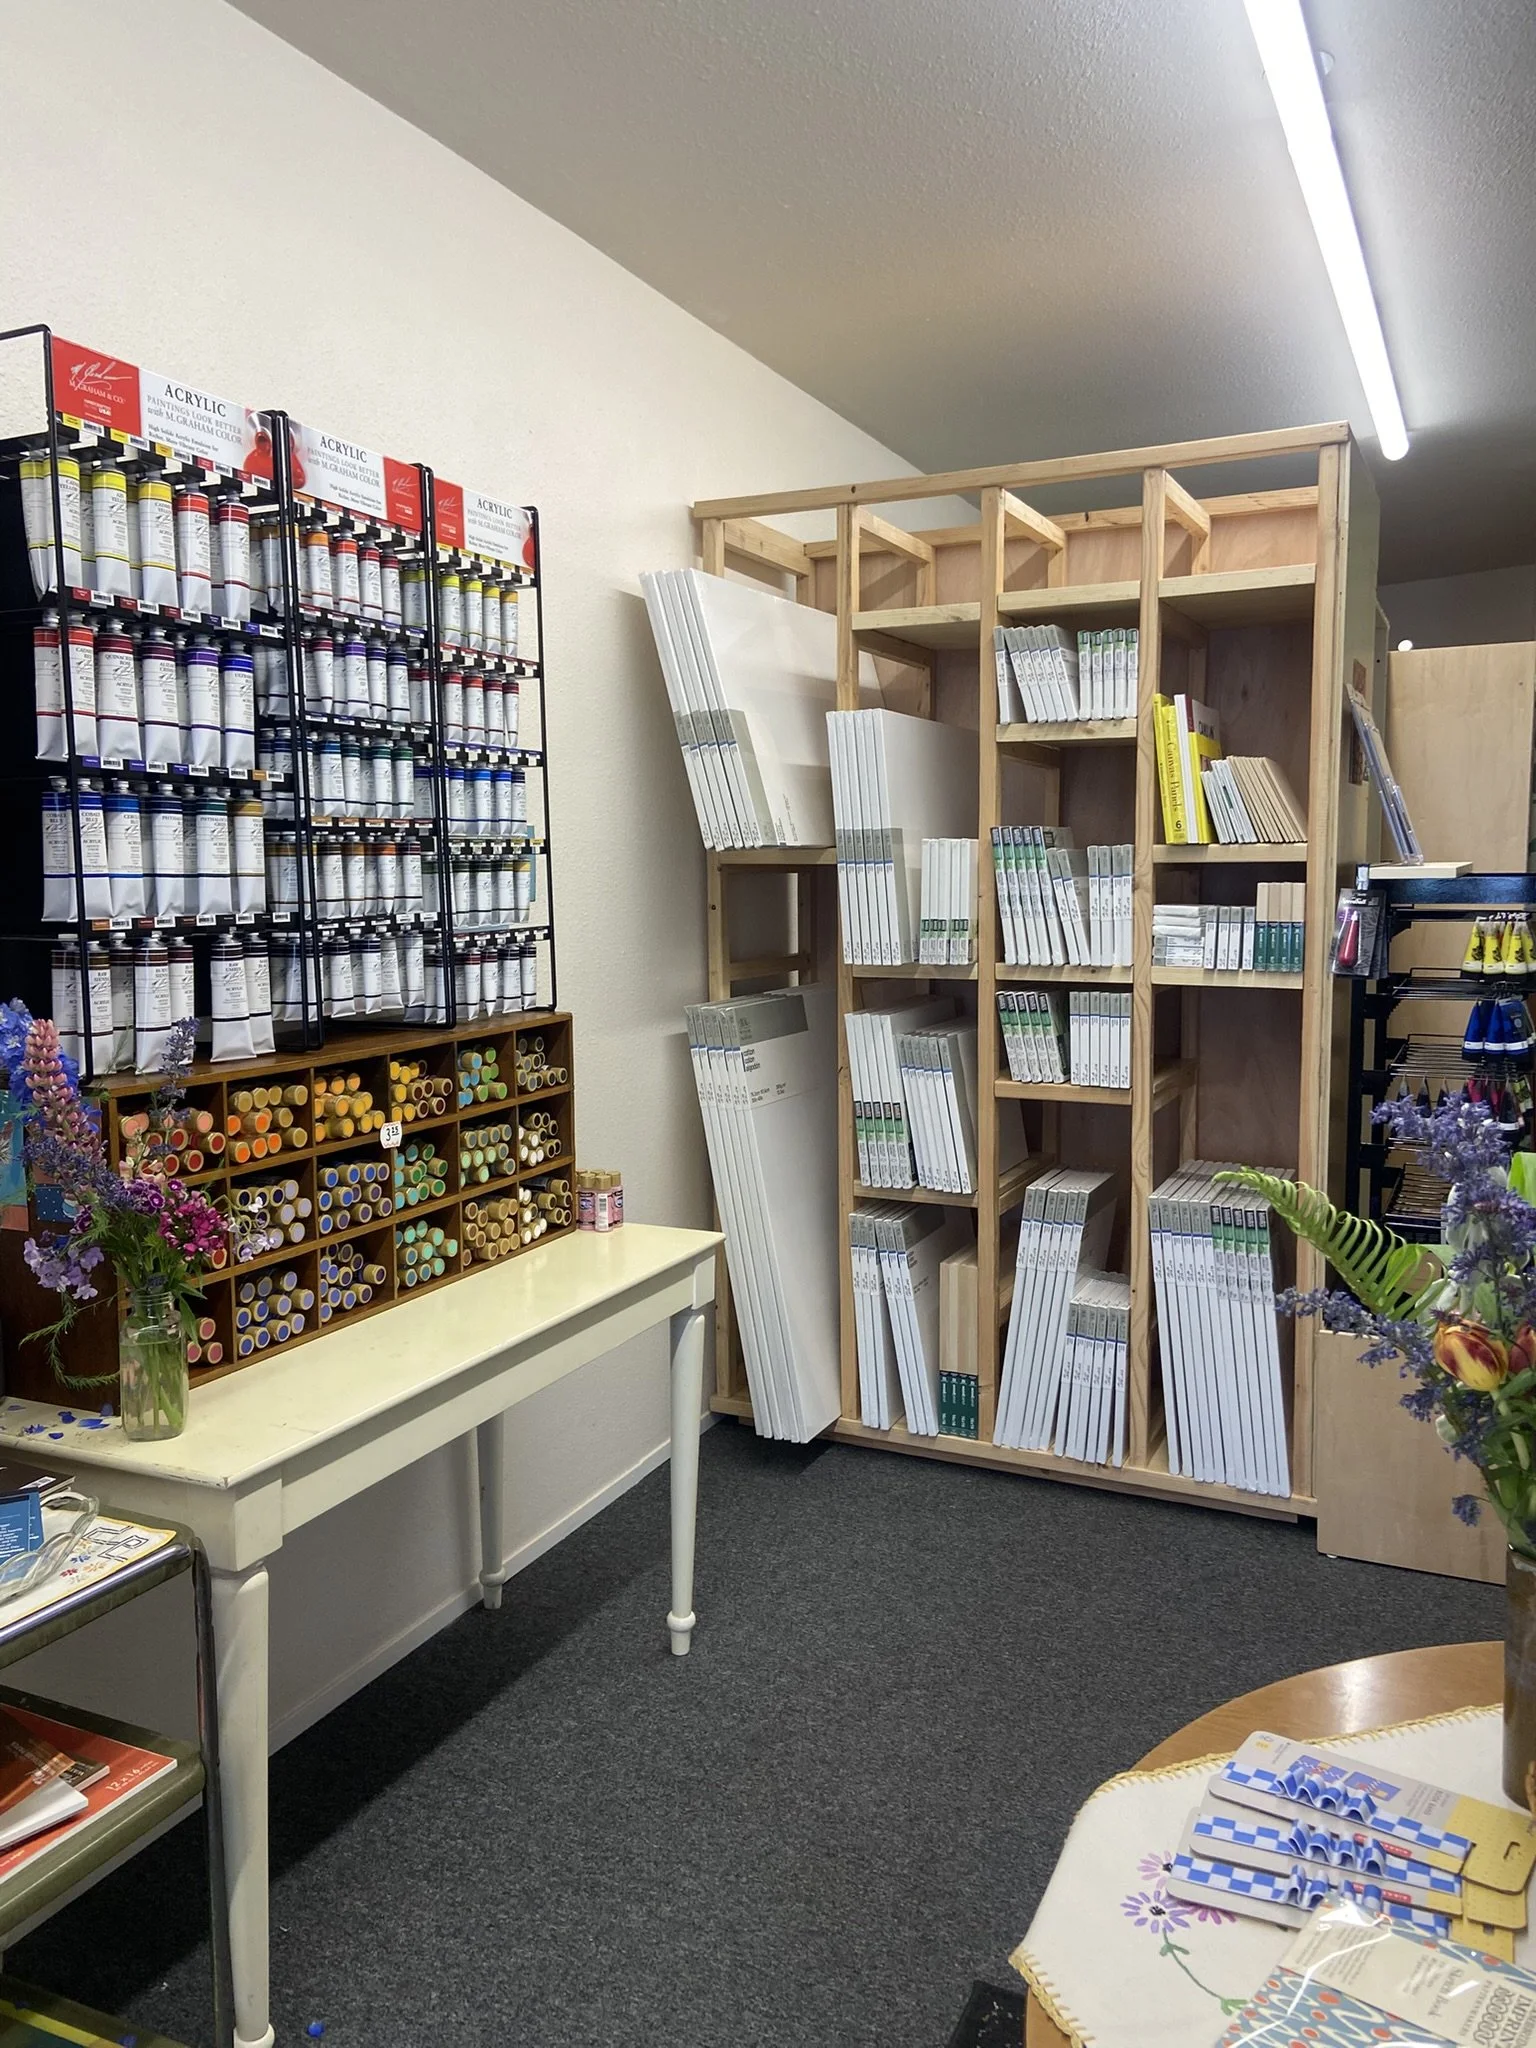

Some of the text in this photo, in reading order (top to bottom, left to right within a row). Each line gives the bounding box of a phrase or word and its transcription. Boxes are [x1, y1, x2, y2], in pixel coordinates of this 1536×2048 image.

[147, 394, 242, 435] PAINTINGS LOOK BETTER
[164, 383, 226, 418] ACRYLIC
[147, 407, 164, 417] with
[215, 429, 243, 445] COLOR
[307, 447, 380, 479] PAINTINGS LOOK BETTER
[320, 435, 368, 464] ACRYLIC
[359, 475, 381, 488] COLOR
[477, 498, 513, 519] ACRYLIC
[1167, 741, 1176, 779] Canvas
[1169, 780, 1181, 813] Panels
[1176, 820, 1182, 829] 6
